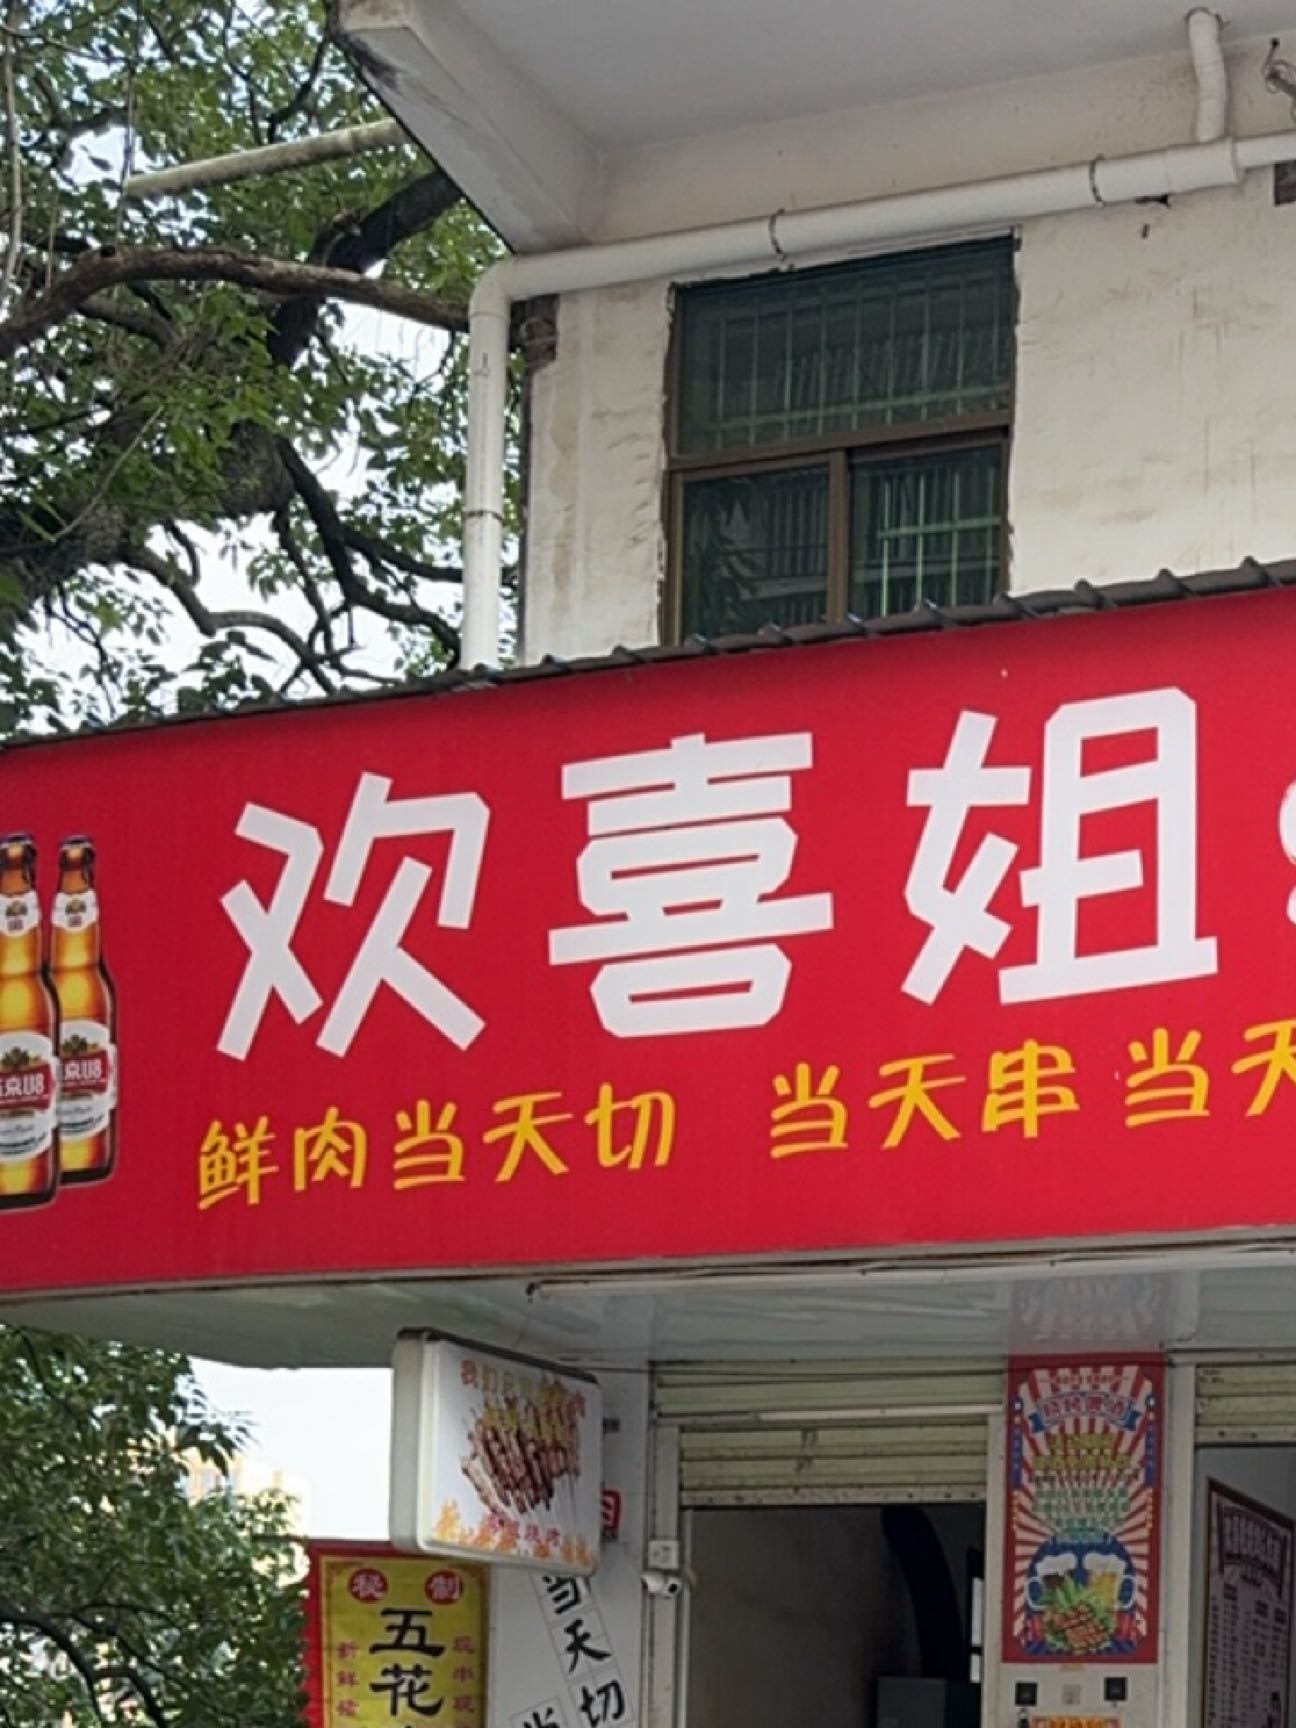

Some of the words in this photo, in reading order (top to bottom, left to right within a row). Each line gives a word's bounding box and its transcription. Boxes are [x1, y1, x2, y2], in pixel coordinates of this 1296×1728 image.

[217, 687, 1218, 1061] 欢喜姐
[198, 1084, 676, 1211] 鲜肉当天切
